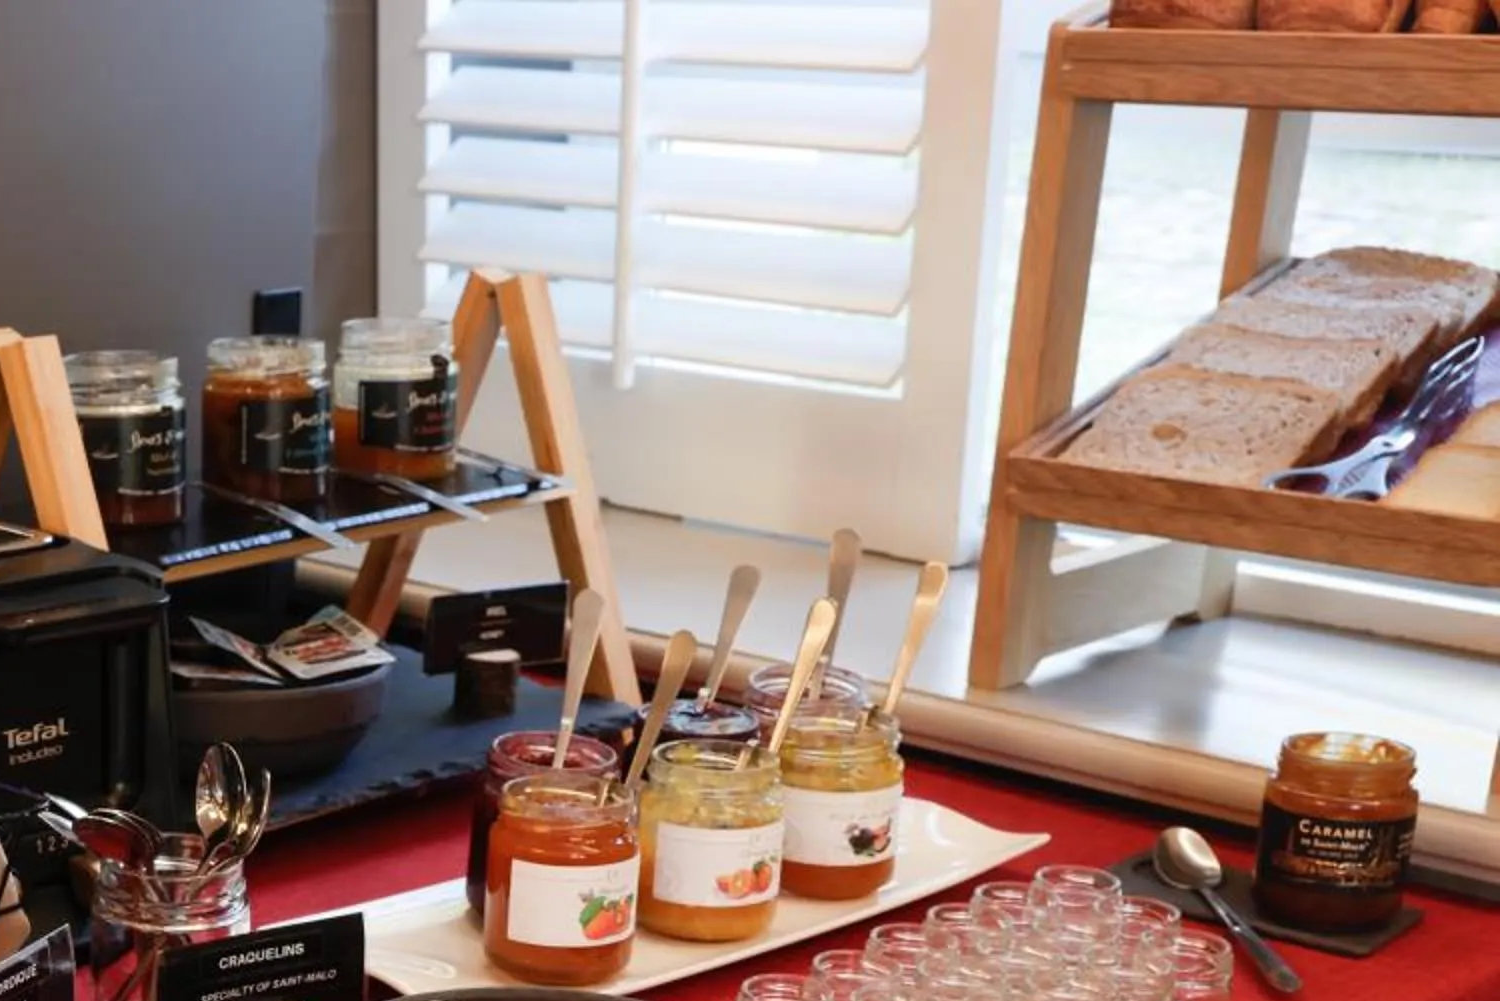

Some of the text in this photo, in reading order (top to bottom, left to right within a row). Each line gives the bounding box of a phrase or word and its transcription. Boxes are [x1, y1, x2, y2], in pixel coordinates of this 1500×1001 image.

[3, 717, 69, 749] Tefal
[1299, 818, 1373, 840] CARAMEL
[218, 942, 305, 970] CRAQUELINS
[255, 980, 271, 993] OF
